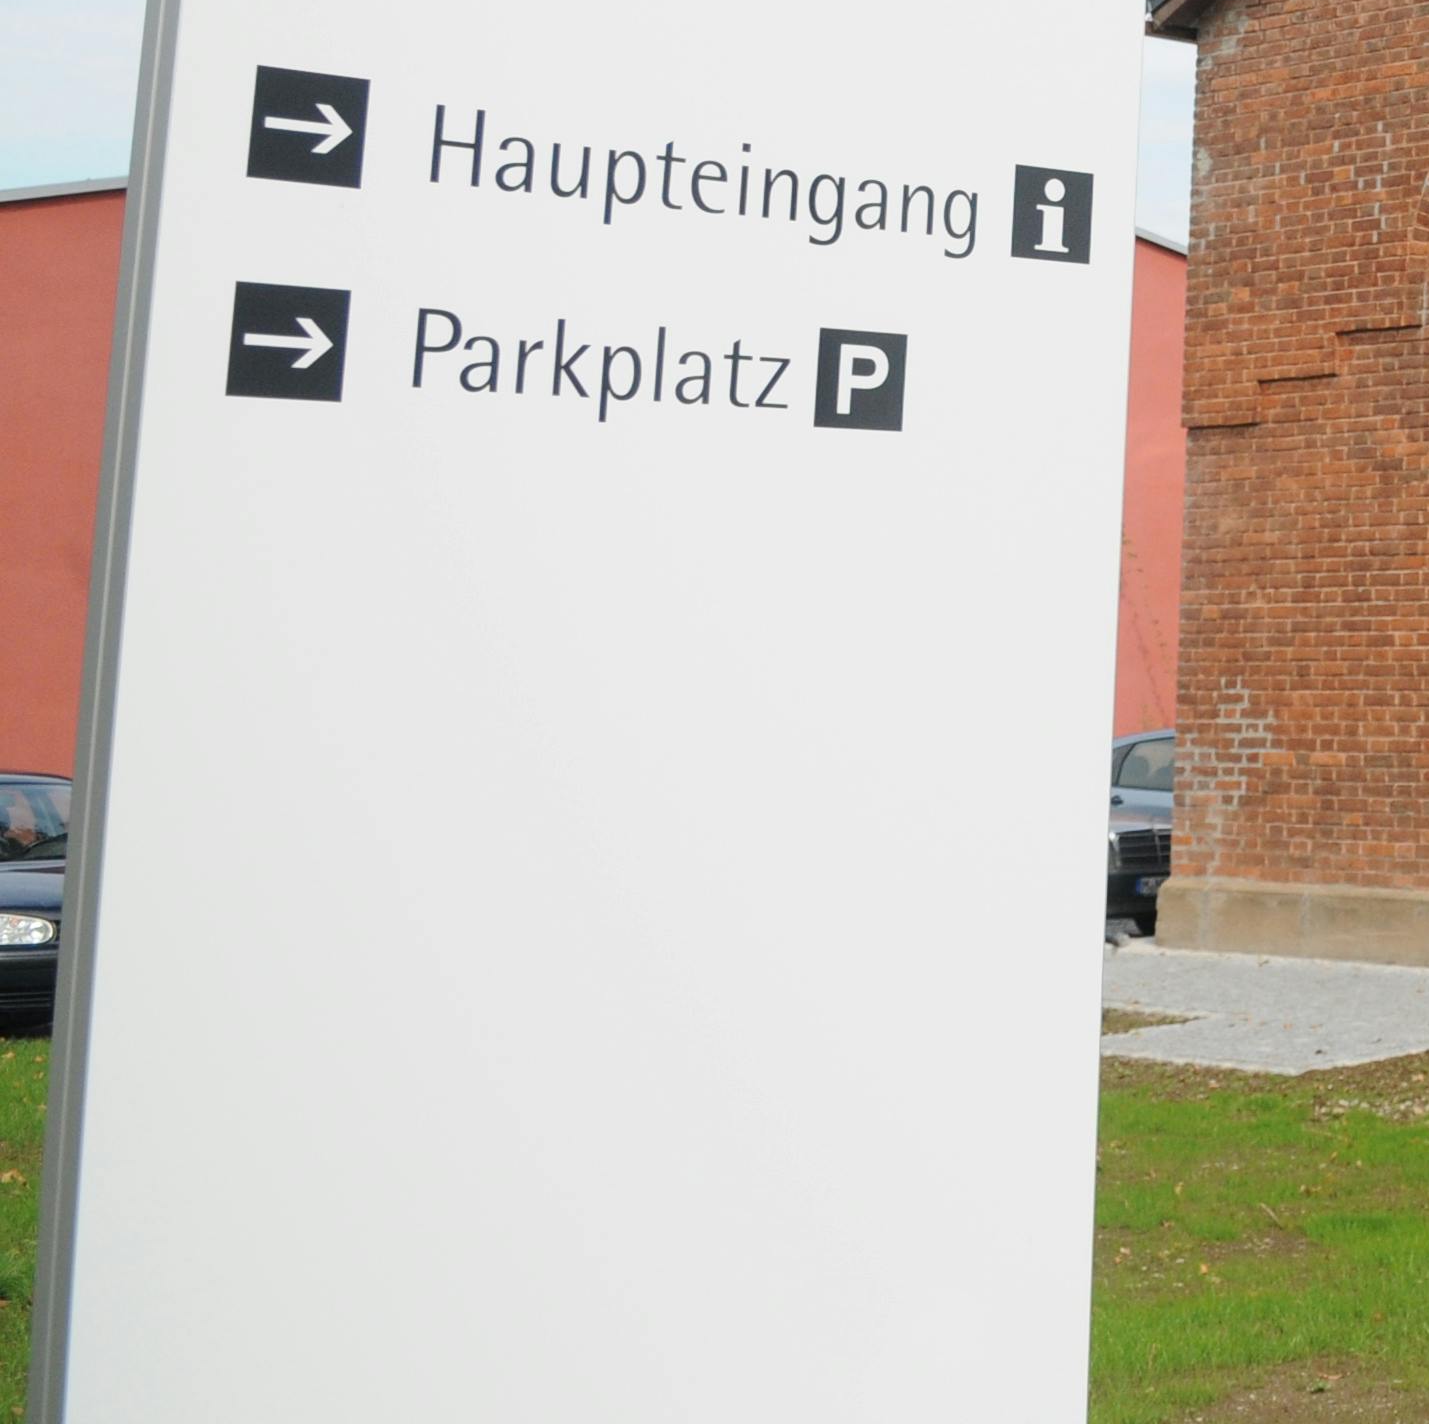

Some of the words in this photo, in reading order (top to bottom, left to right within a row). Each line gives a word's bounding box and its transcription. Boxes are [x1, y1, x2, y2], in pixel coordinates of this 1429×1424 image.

[429, 104, 979, 259] Haupteingang
[411, 307, 791, 423] Parkplatz
[836, 343, 890, 415] P
